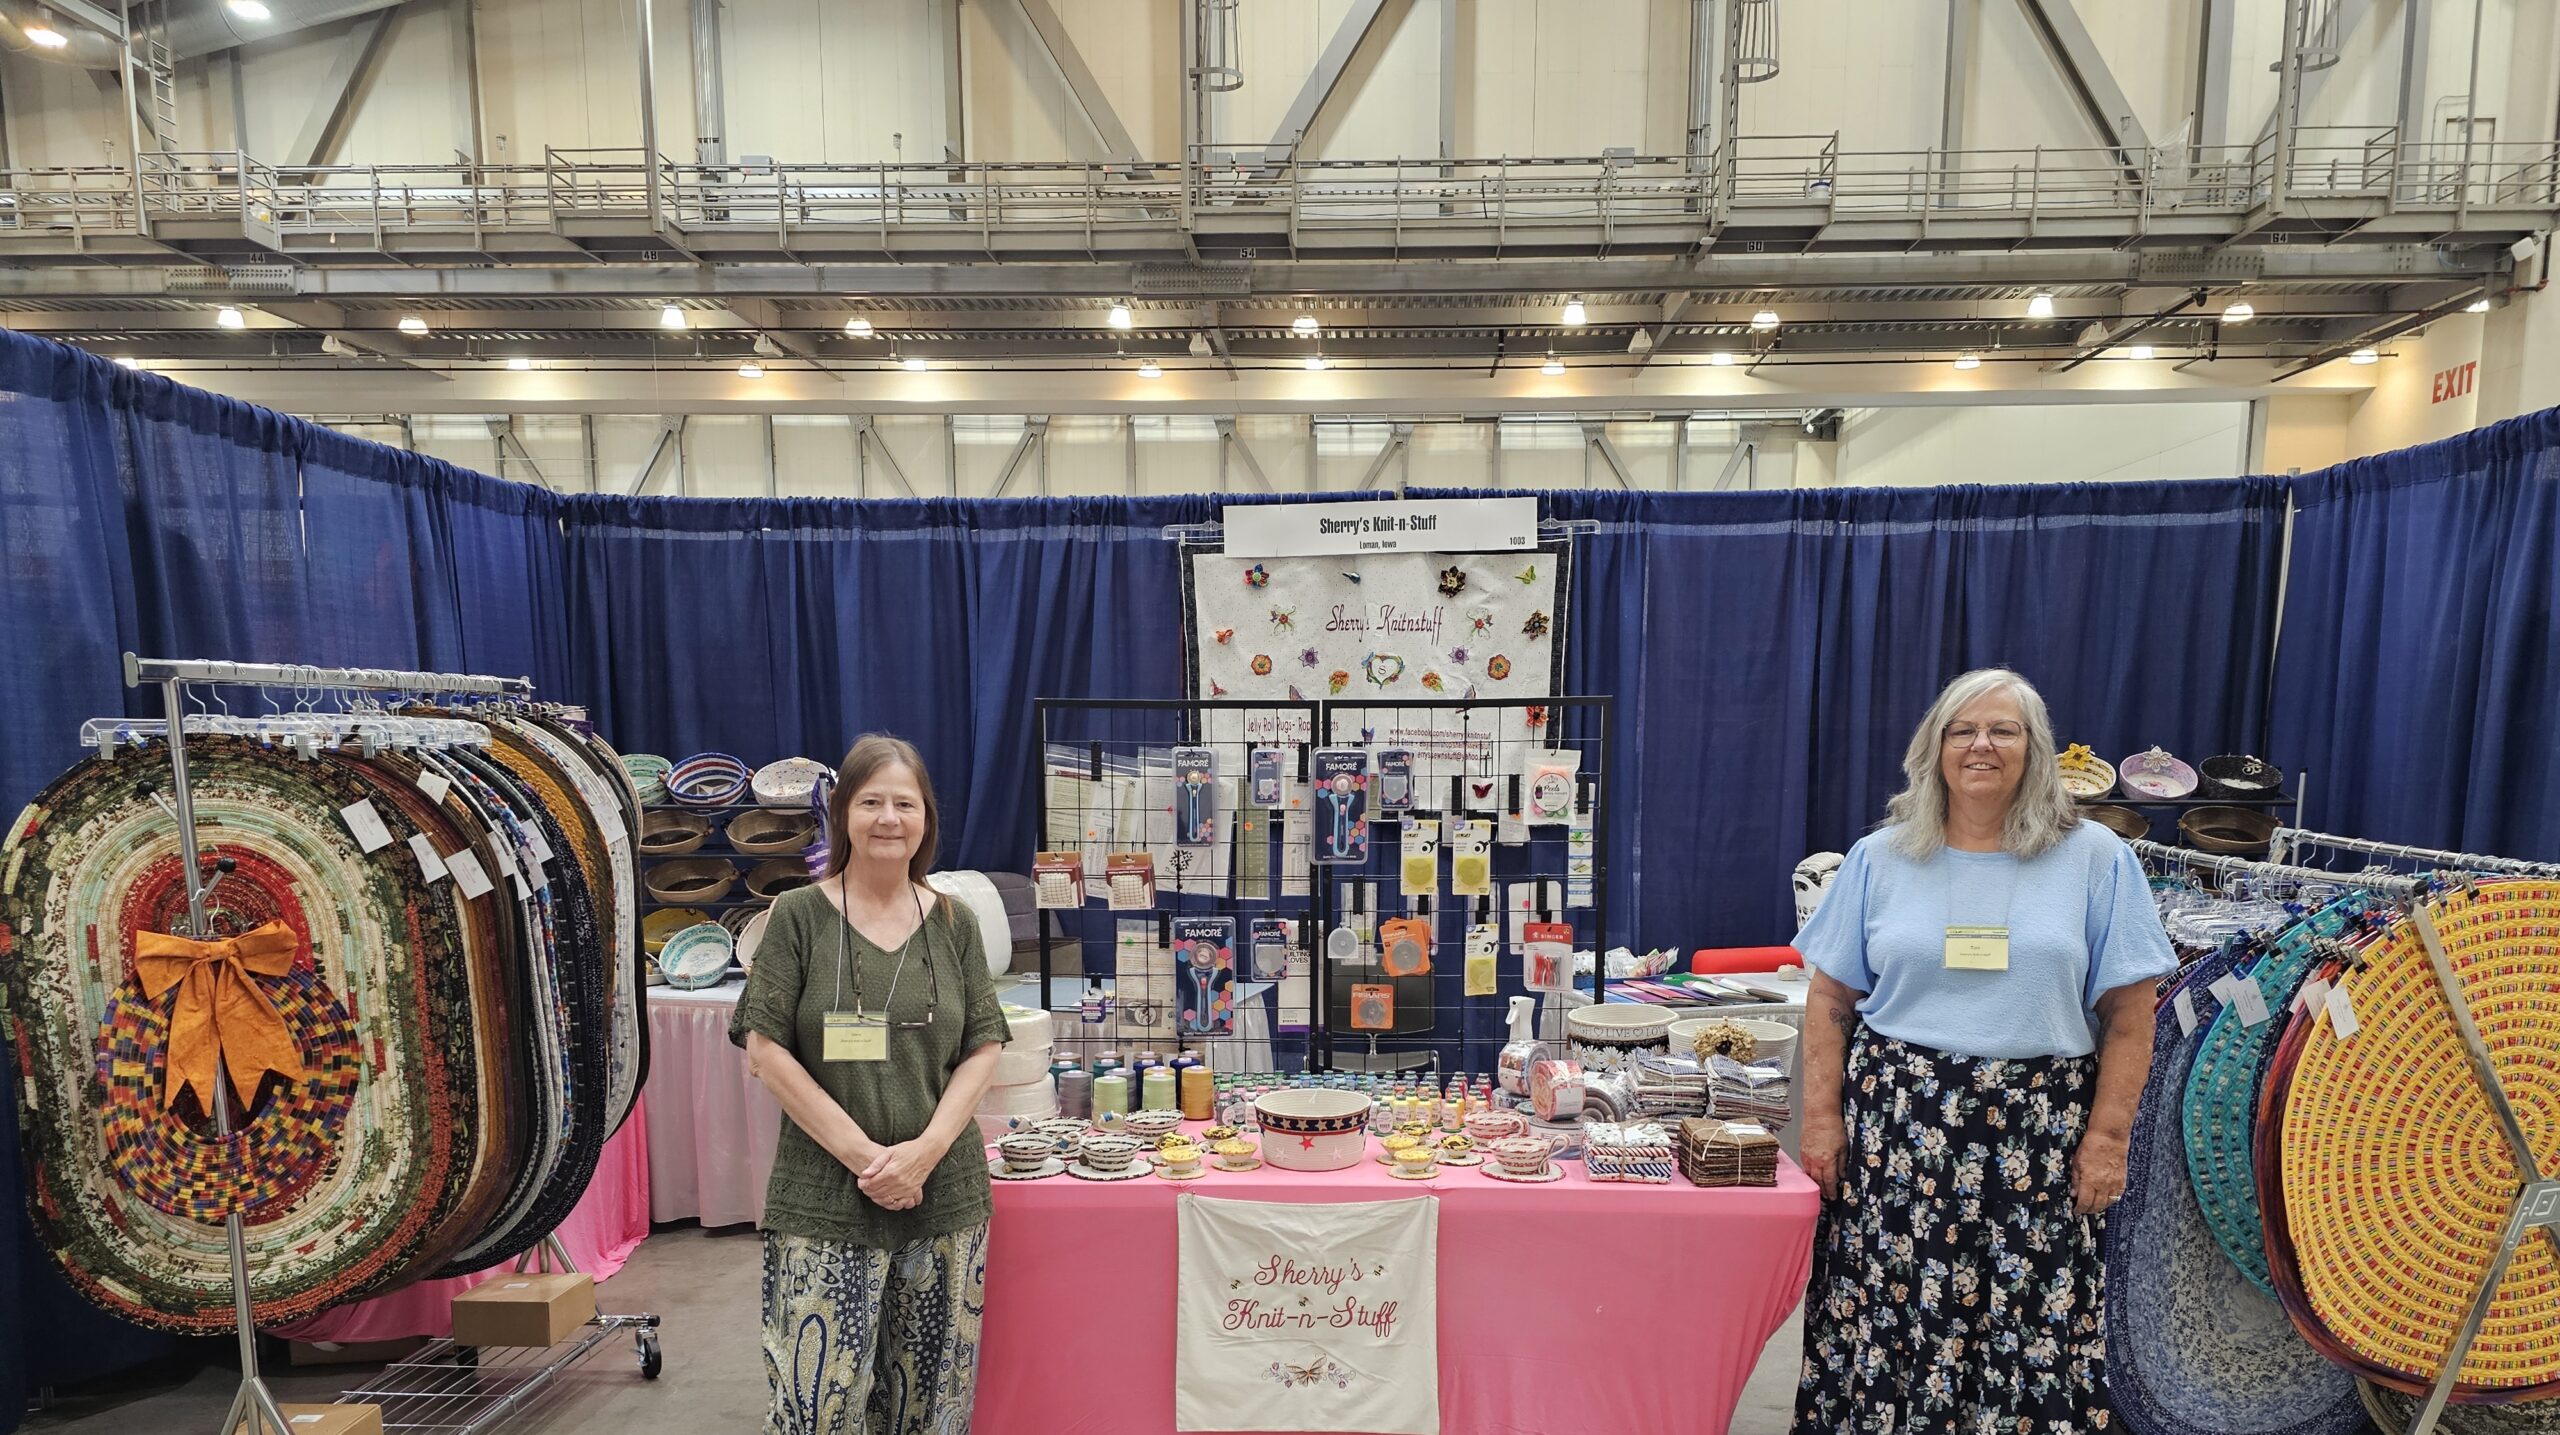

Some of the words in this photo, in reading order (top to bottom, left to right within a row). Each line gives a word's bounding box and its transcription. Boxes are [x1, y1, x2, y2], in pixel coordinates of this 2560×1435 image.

[2272, 232, 2287, 243] 64
[1748, 241, 1763, 251] 60
[250, 252, 264, 263] 44
[1241, 247, 1255, 258] 54
[2431, 360, 2477, 405] EXIT
[1319, 517, 1370, 536] Sherry's
[1373, 514, 1438, 532] Knit-n-Stuff
[1359, 540, 1381, 550] Loman,
[1382, 539, 1397, 549] Iowa
[1509, 536, 1526, 546] 1003
[1325, 603, 1370, 643] Sherry's
[1376, 604, 1444, 647] Knitnstuff
[1247, 717, 1262, 735] Jelly
[1325, 761, 1358, 771] FAMORÉ
[1184, 927, 1223, 938] FAMORÉ
[1606, 1028, 1631, 1038] LIVE
[1253, 1254, 1364, 1296] Sherry's
[1222, 1295, 1399, 1338] Knit-n-Stuff
